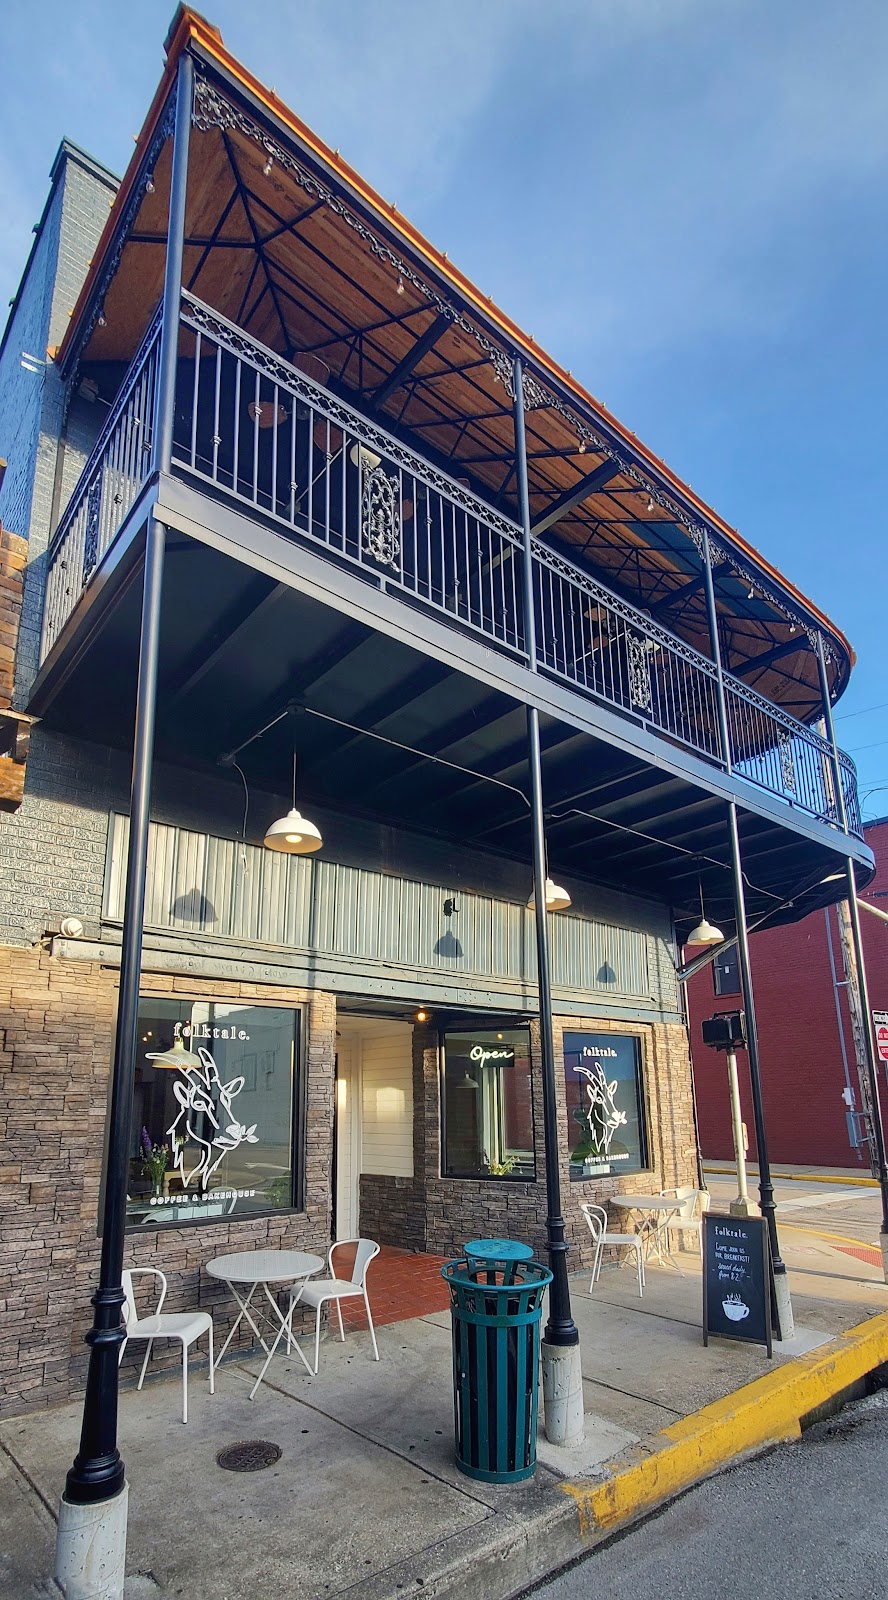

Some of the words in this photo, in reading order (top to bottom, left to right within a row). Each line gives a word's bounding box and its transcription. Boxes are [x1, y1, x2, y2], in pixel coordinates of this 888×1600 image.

[173, 1022, 250, 1040] folktale.
[470, 1046, 514, 1068] Open
[583, 1046, 617, 1057] folktale.
[150, 1194, 188, 1205] COFFEE
[192, 1194, 198, 1202] &
[202, 1189, 255, 1200] BAKEHOUSE
